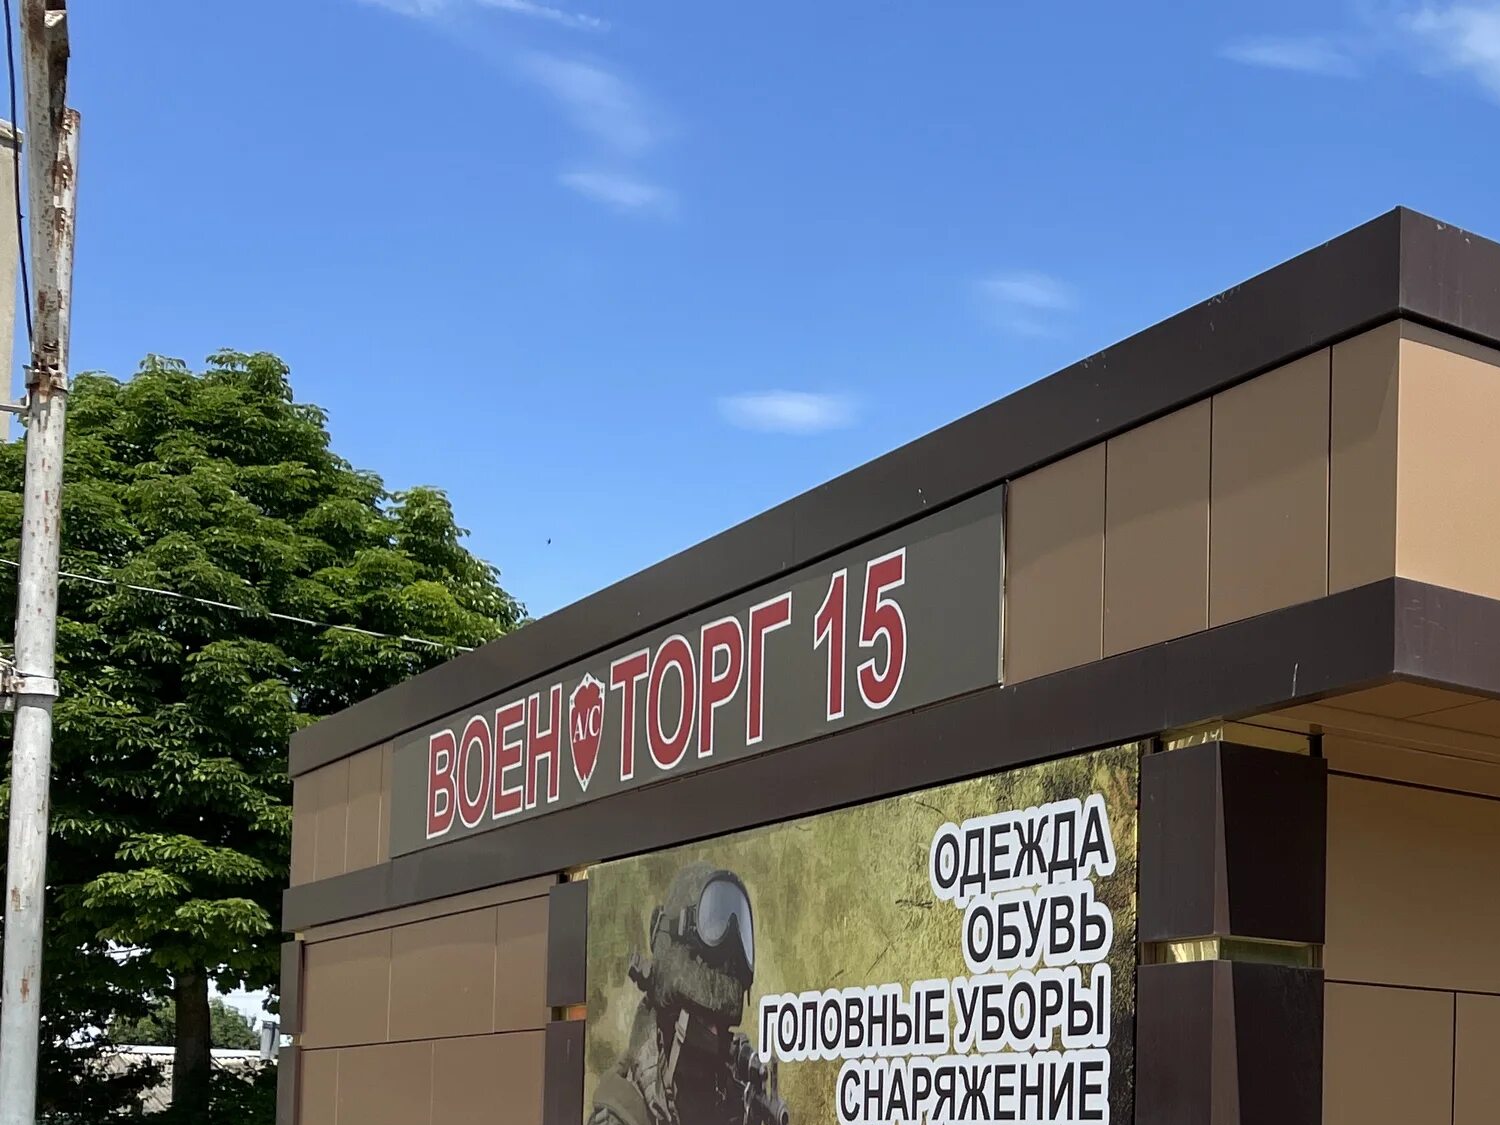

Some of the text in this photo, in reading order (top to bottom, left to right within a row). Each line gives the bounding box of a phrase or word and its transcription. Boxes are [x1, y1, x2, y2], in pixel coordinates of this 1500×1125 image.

[426, 682, 563, 840] ВОЕН
[610, 591, 792, 781] ТОРГ
[813, 547, 907, 721] 15
[934, 804, 1109, 898] ОДЕЖДА
[966, 891, 1108, 964] ОБУВЬ
[761, 975, 1105, 1055] ГОЛОВНЫЕ УБОРЫ
[840, 1060, 1105, 1123] СНАРЯЖЕНИЕ
